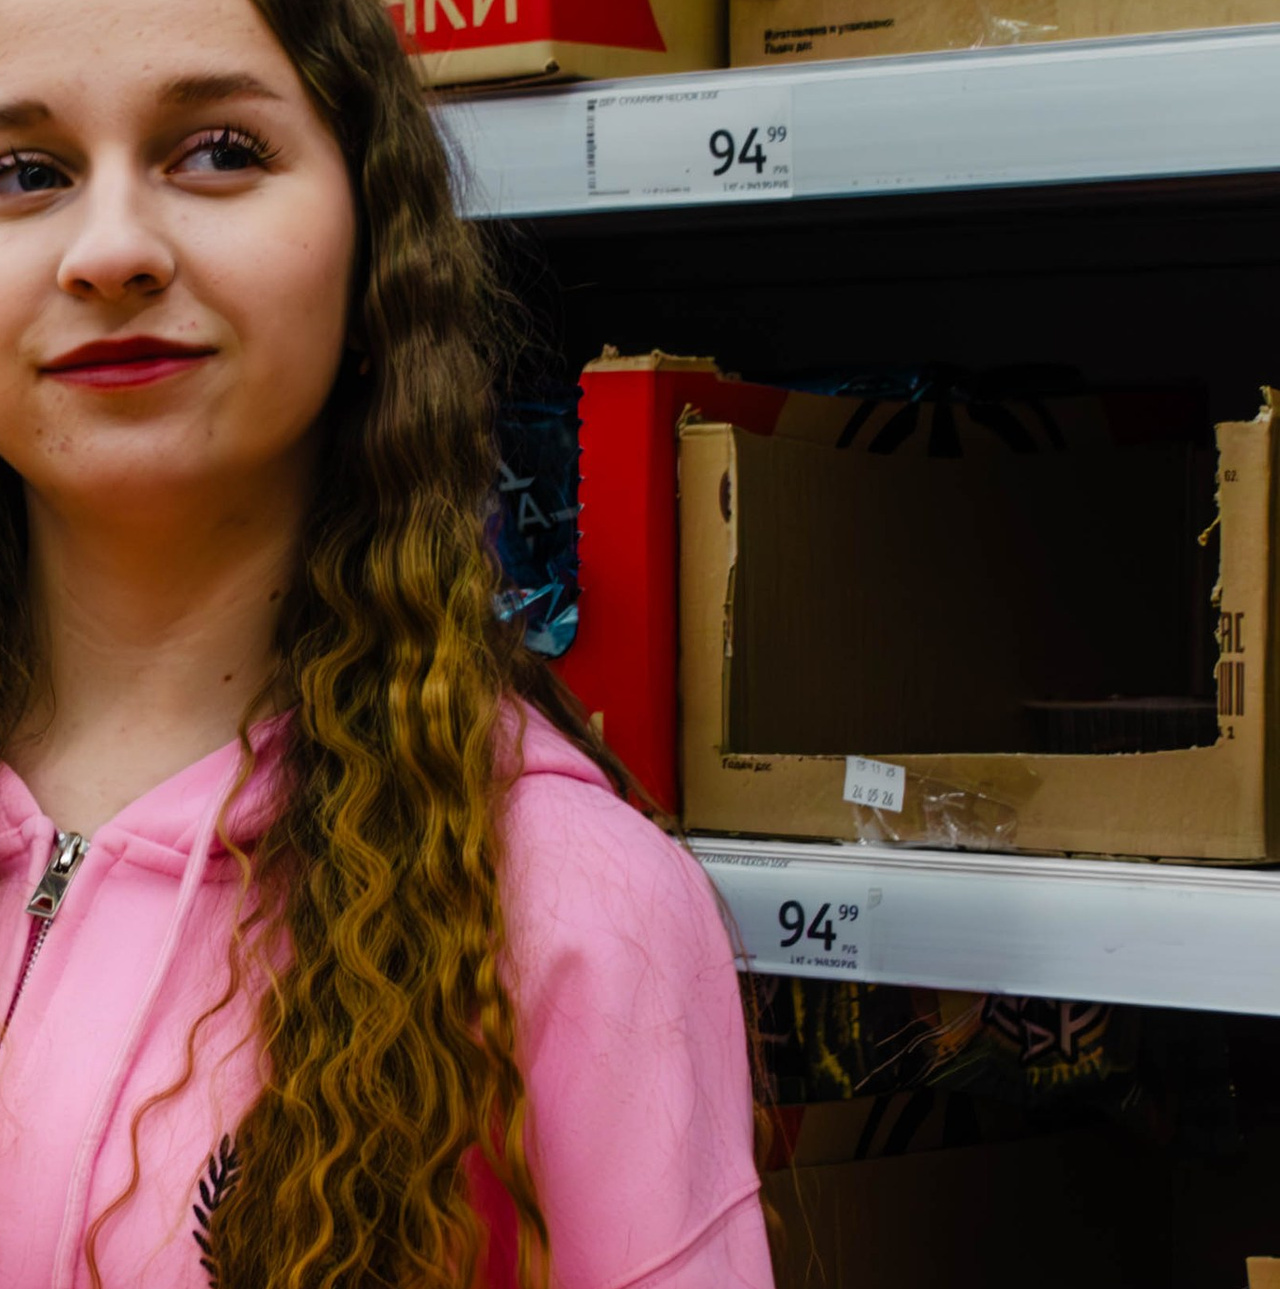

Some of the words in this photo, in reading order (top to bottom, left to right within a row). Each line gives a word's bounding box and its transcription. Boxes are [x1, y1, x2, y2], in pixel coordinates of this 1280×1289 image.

[708, 127, 767, 176] 94
[767, 125, 787, 144] 99
[778, 900, 837, 952] 94
[838, 903, 860, 922] 99
